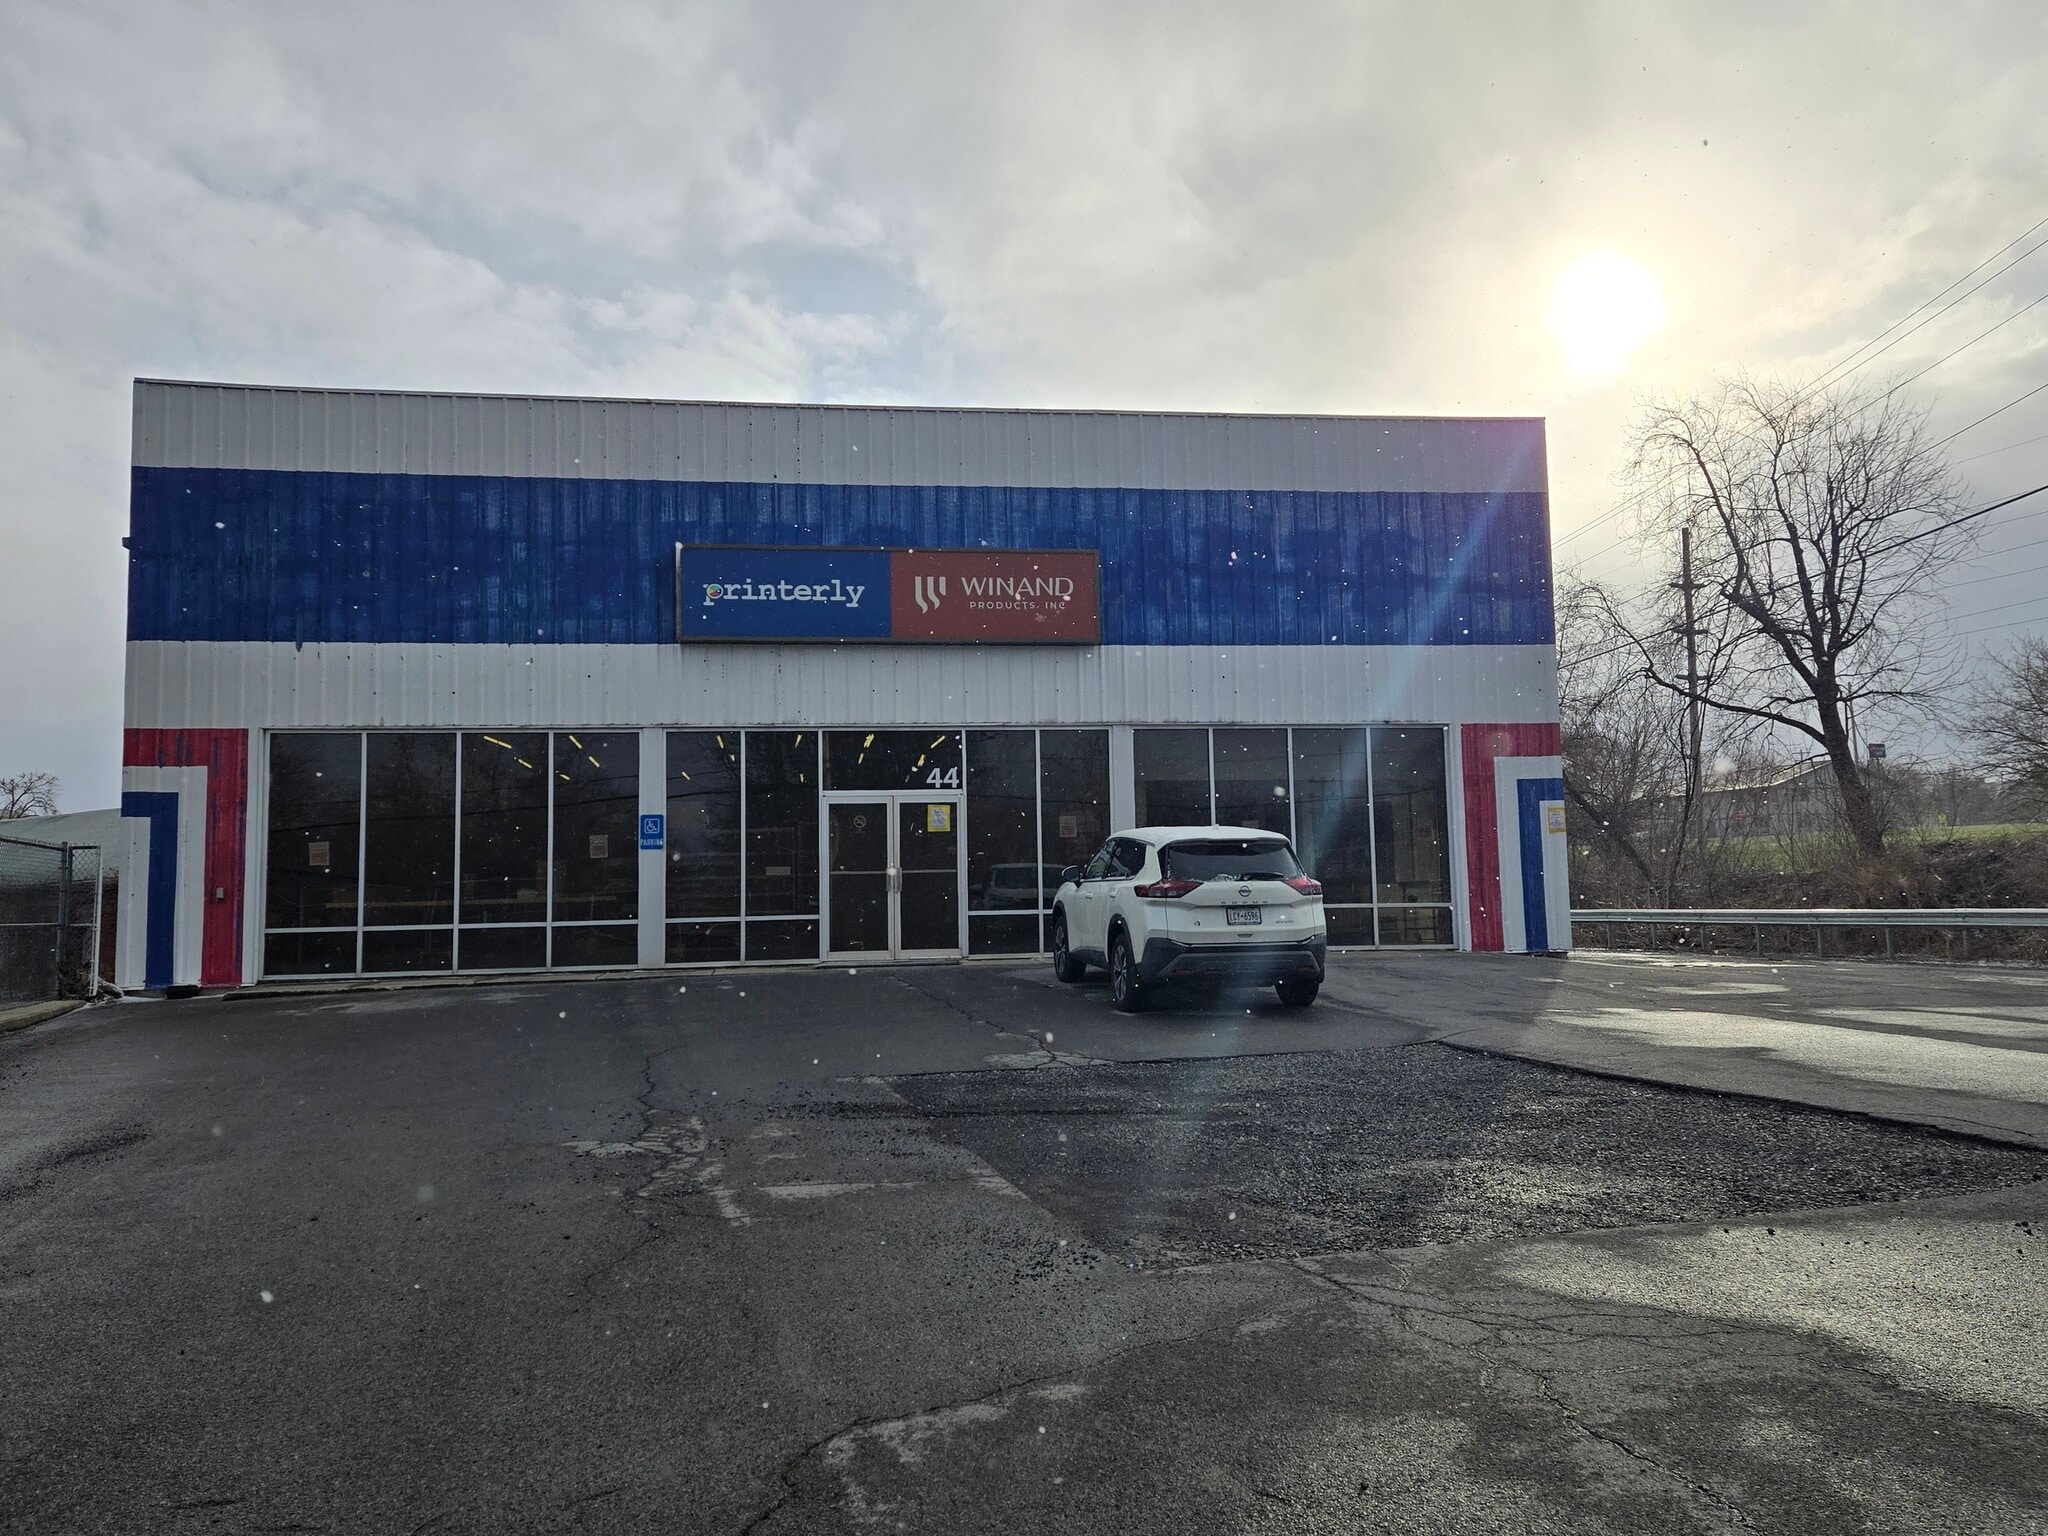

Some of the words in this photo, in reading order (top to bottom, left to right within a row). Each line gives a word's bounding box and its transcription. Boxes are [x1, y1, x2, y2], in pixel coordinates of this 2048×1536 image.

[702, 578, 866, 608] printerly
[961, 576, 1074, 597] WINAND
[1045, 601, 1066, 610] INC
[926, 767, 960, 788] 44
